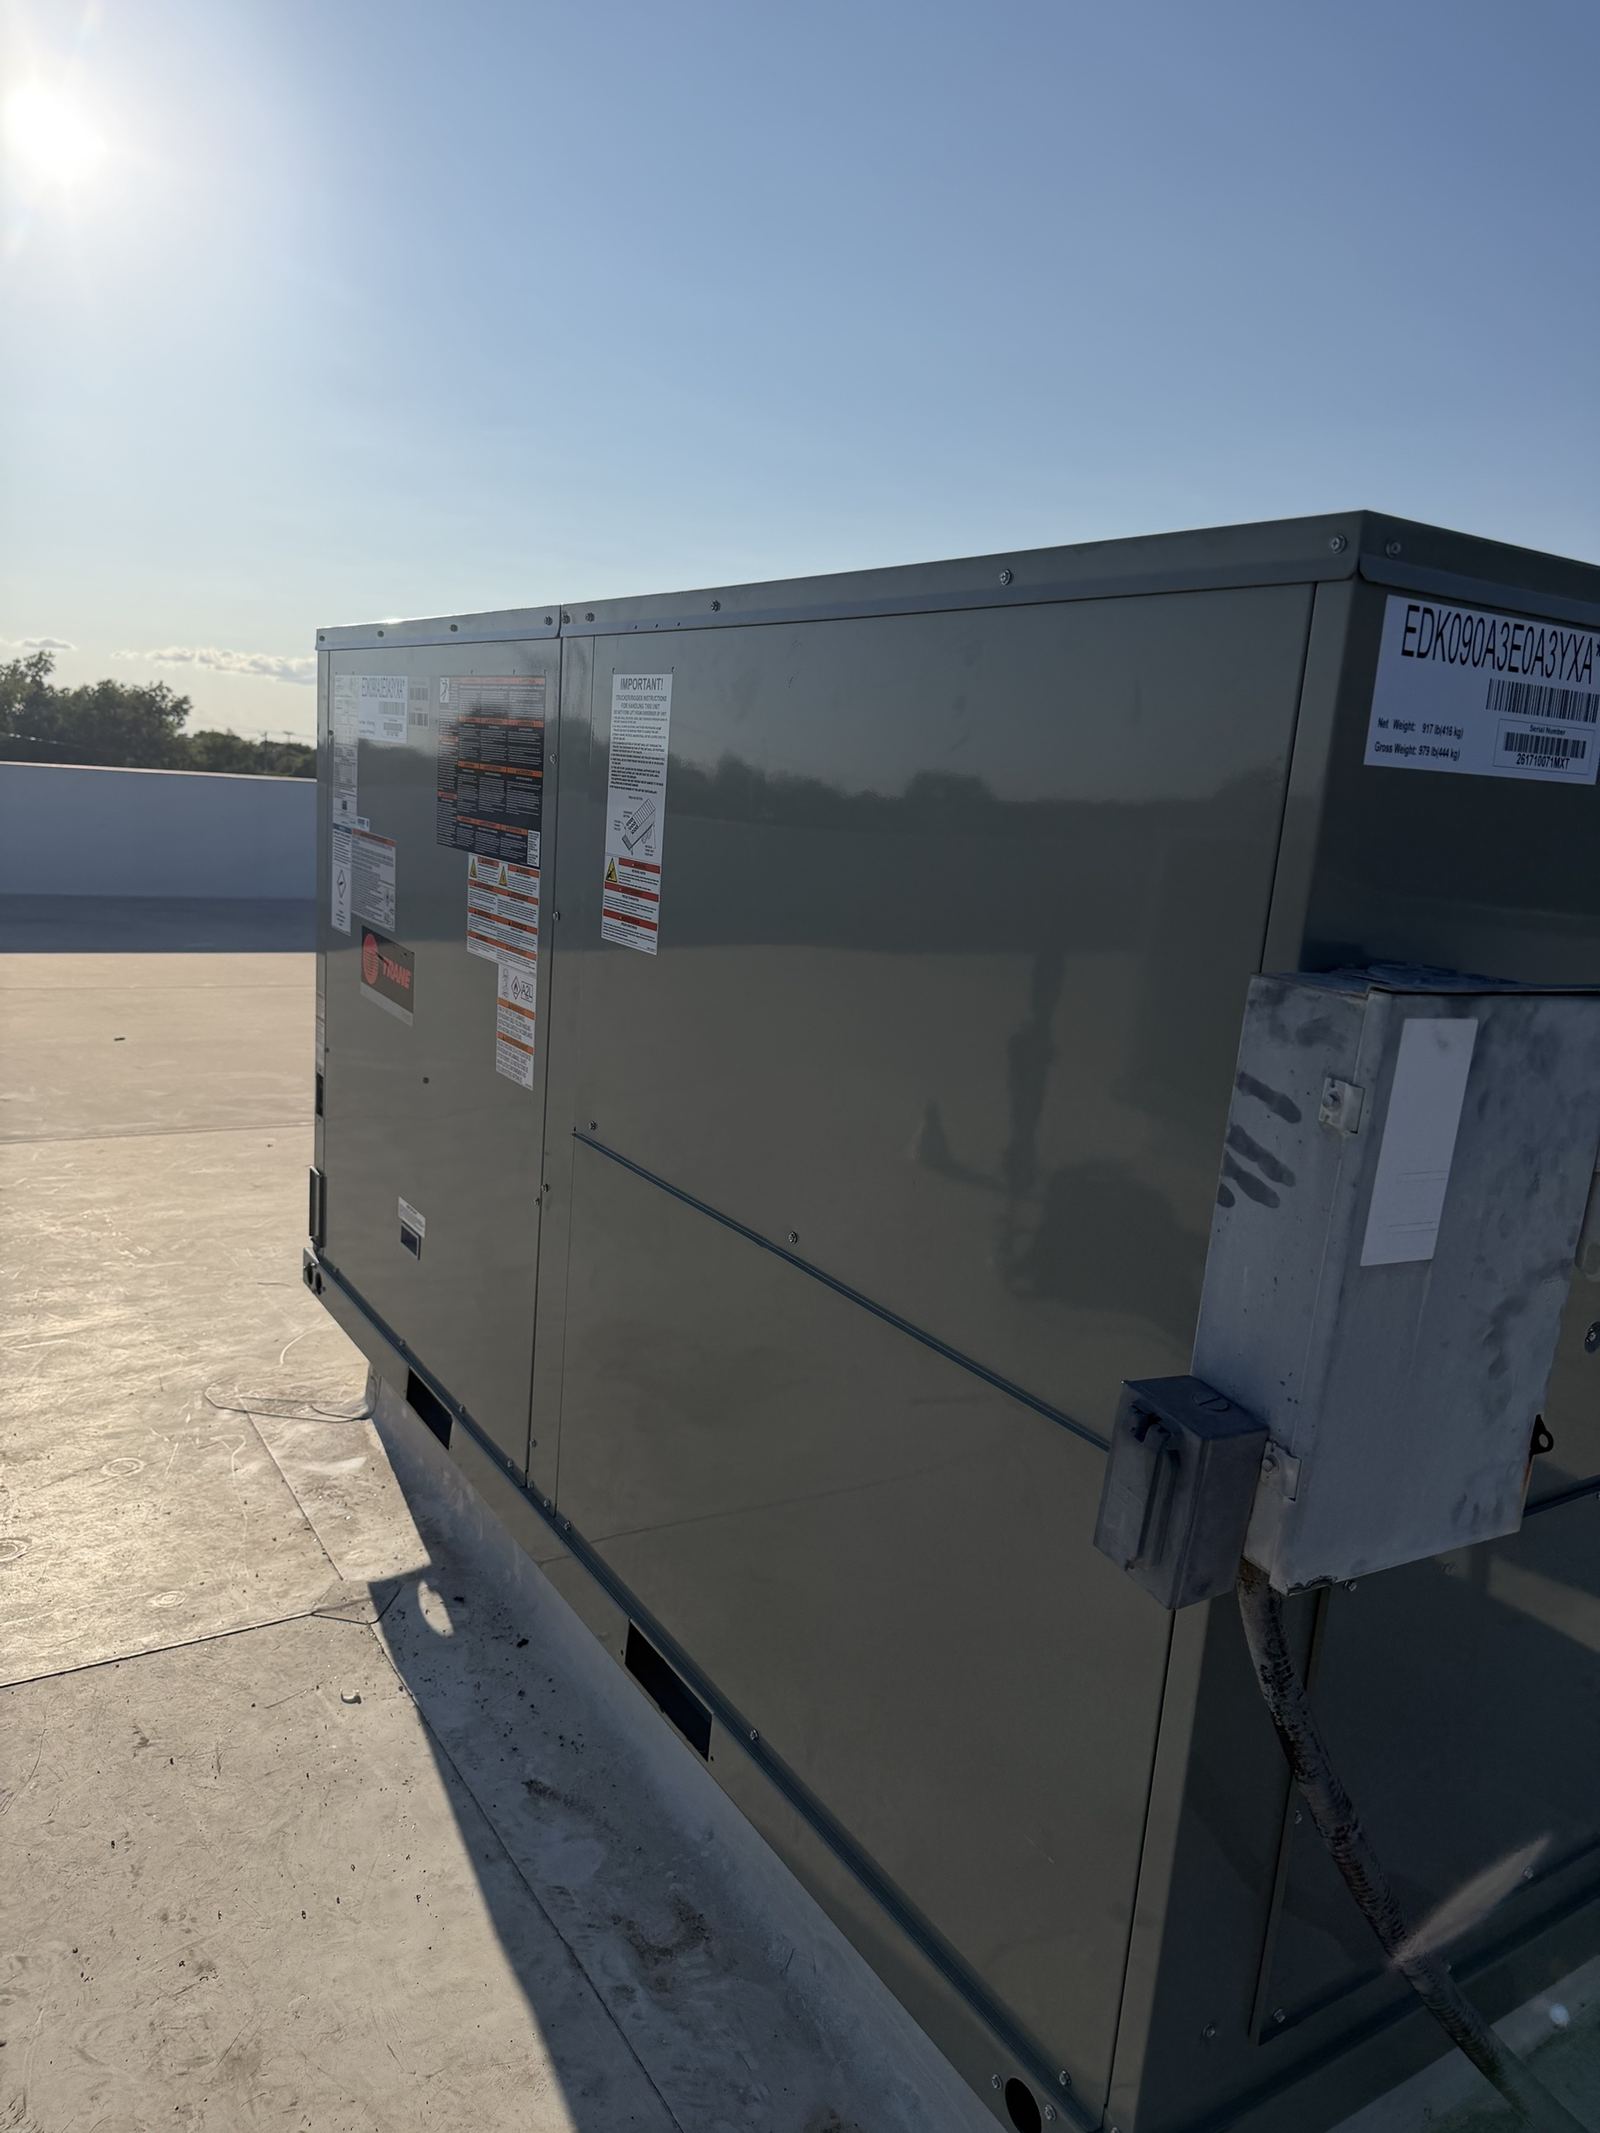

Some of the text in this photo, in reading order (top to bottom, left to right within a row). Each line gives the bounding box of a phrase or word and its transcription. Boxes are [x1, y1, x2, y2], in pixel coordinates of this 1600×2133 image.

[621, 678, 664, 690] IMPORTANT!
[1377, 717, 1389, 729] Net
[1393, 719, 1416, 733] Weight:
[1422, 723, 1433, 734] 917
[1454, 726, 1464, 739] kg)
[1529, 724, 1566, 735] Serial Number
[1374, 741, 1393, 753] Gross
[1394, 743, 1417, 757] Weight:
[1450, 748, 1460, 761] kg)
[383, 957, 411, 989] TRANE
